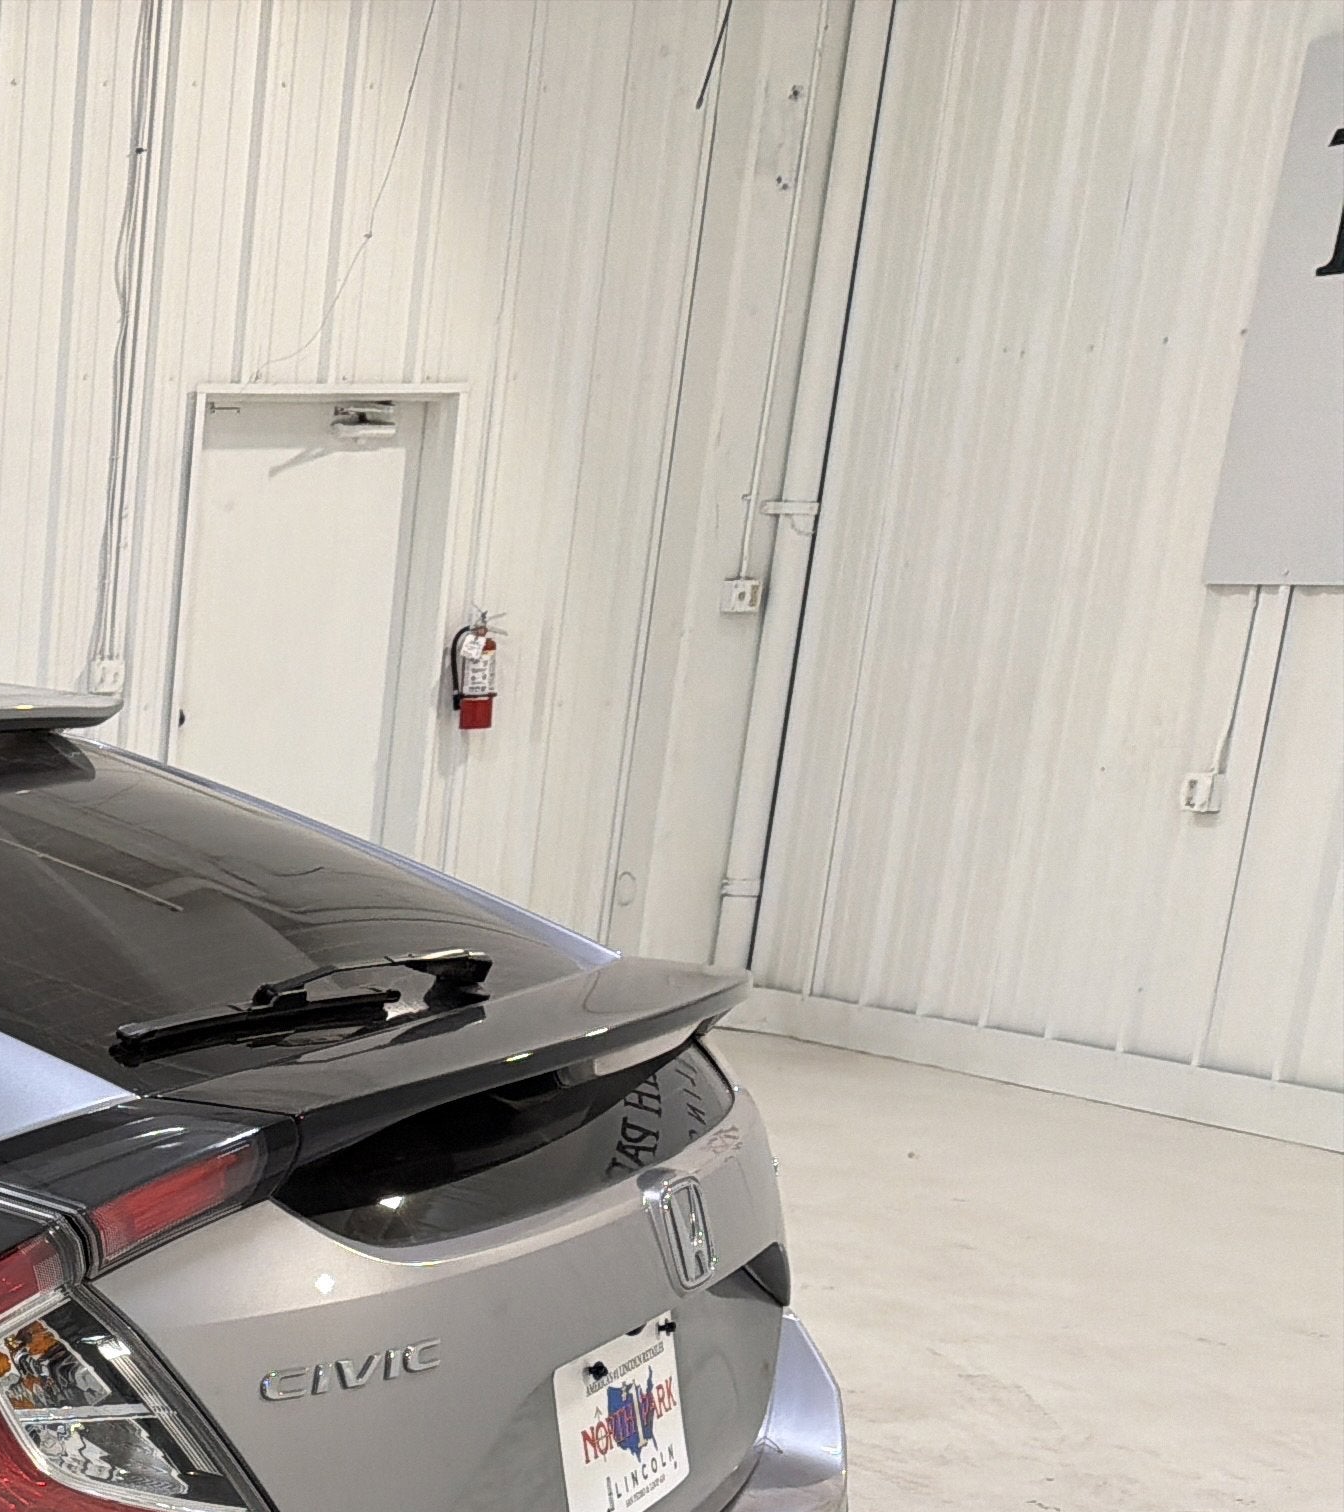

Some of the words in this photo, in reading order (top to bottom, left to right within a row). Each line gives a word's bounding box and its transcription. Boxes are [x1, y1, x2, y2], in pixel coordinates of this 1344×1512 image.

[260, 1337, 441, 1402] CIVIC
[581, 1413, 637, 1465] NORTH
[640, 1375, 677, 1425] PARK
[614, 1444, 675, 1498] LINCOLN
